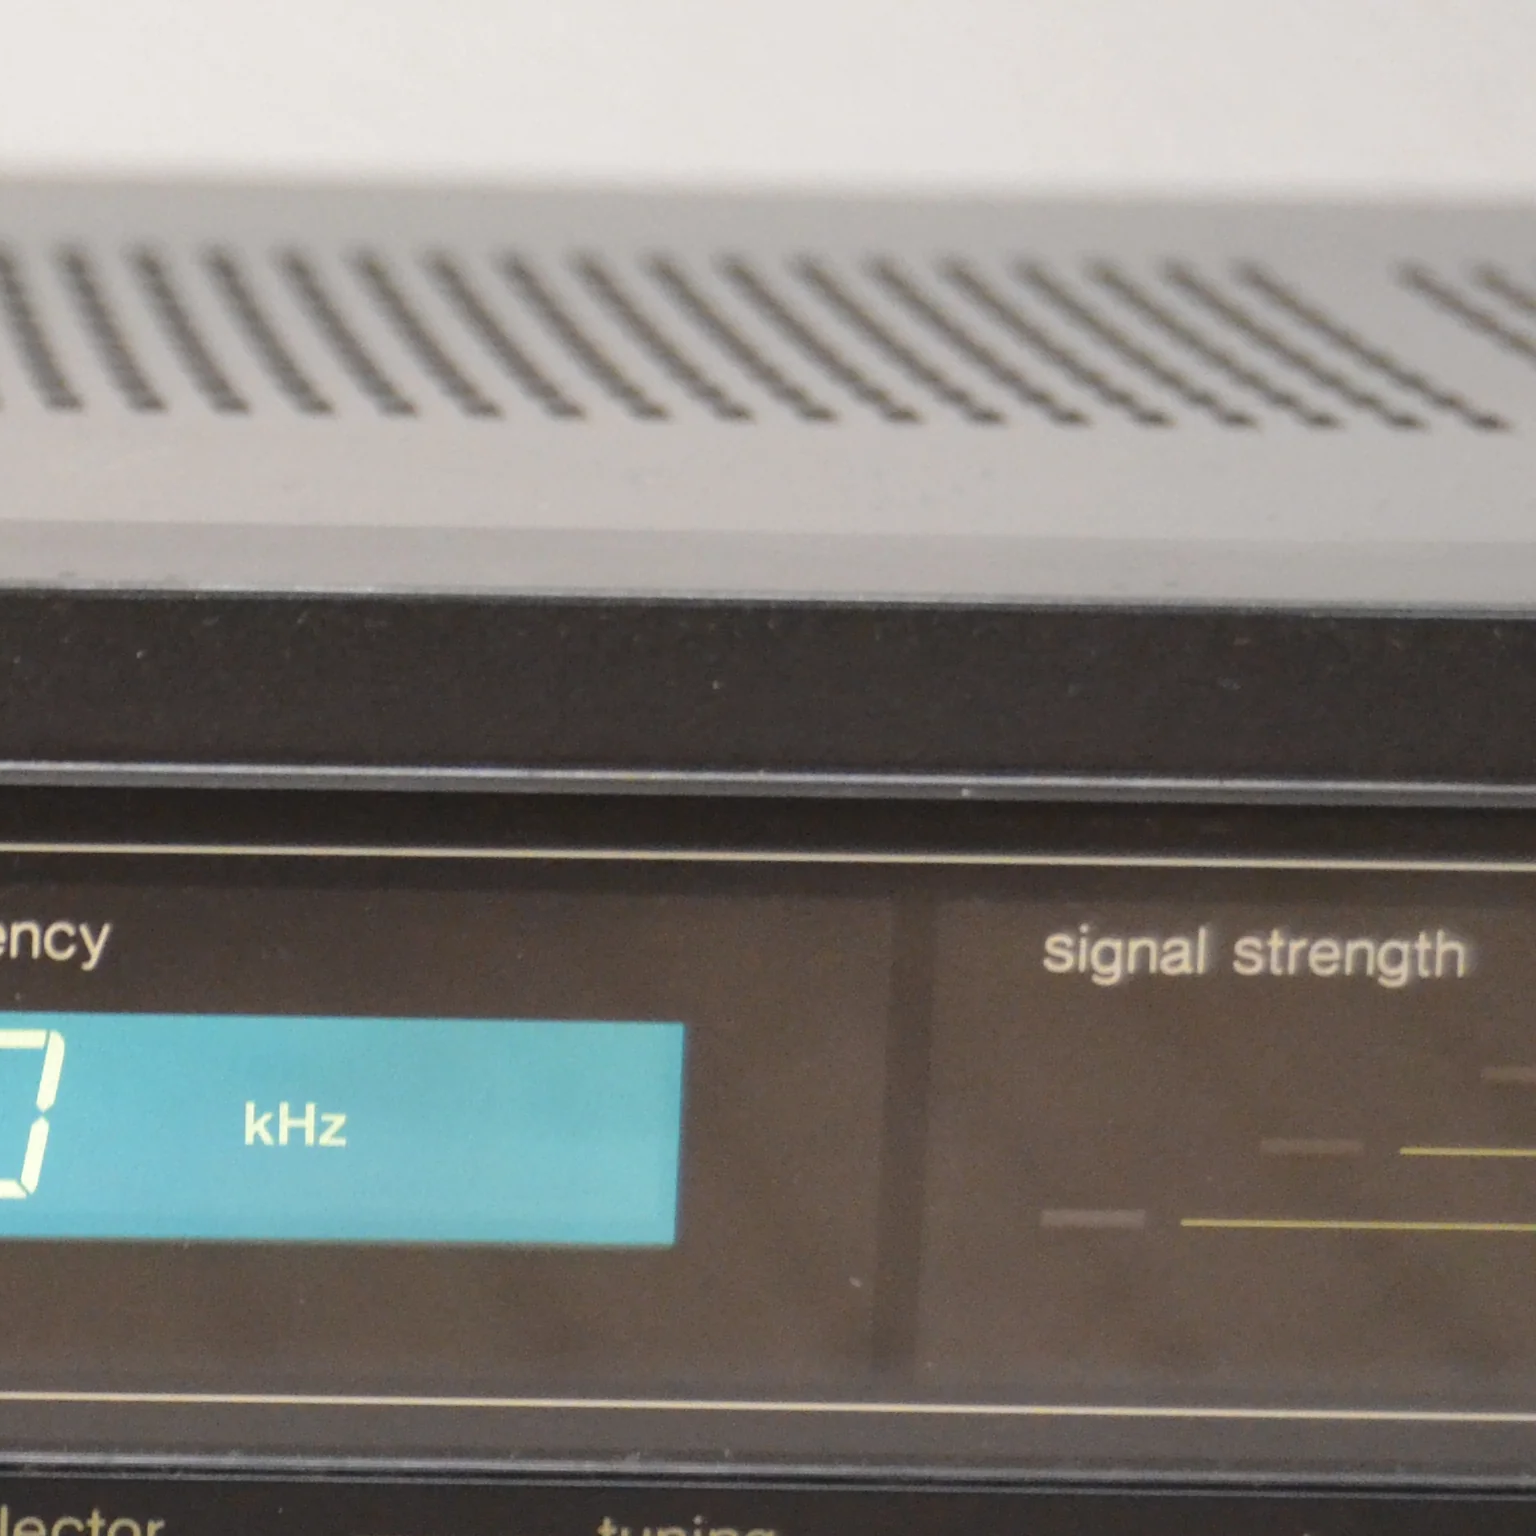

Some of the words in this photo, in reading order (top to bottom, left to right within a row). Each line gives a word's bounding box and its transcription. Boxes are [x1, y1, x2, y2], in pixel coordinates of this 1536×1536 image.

[1042, 926, 1209, 985] signal
[1231, 929, 1469, 988] strength
[242, 1101, 349, 1149] kHz
